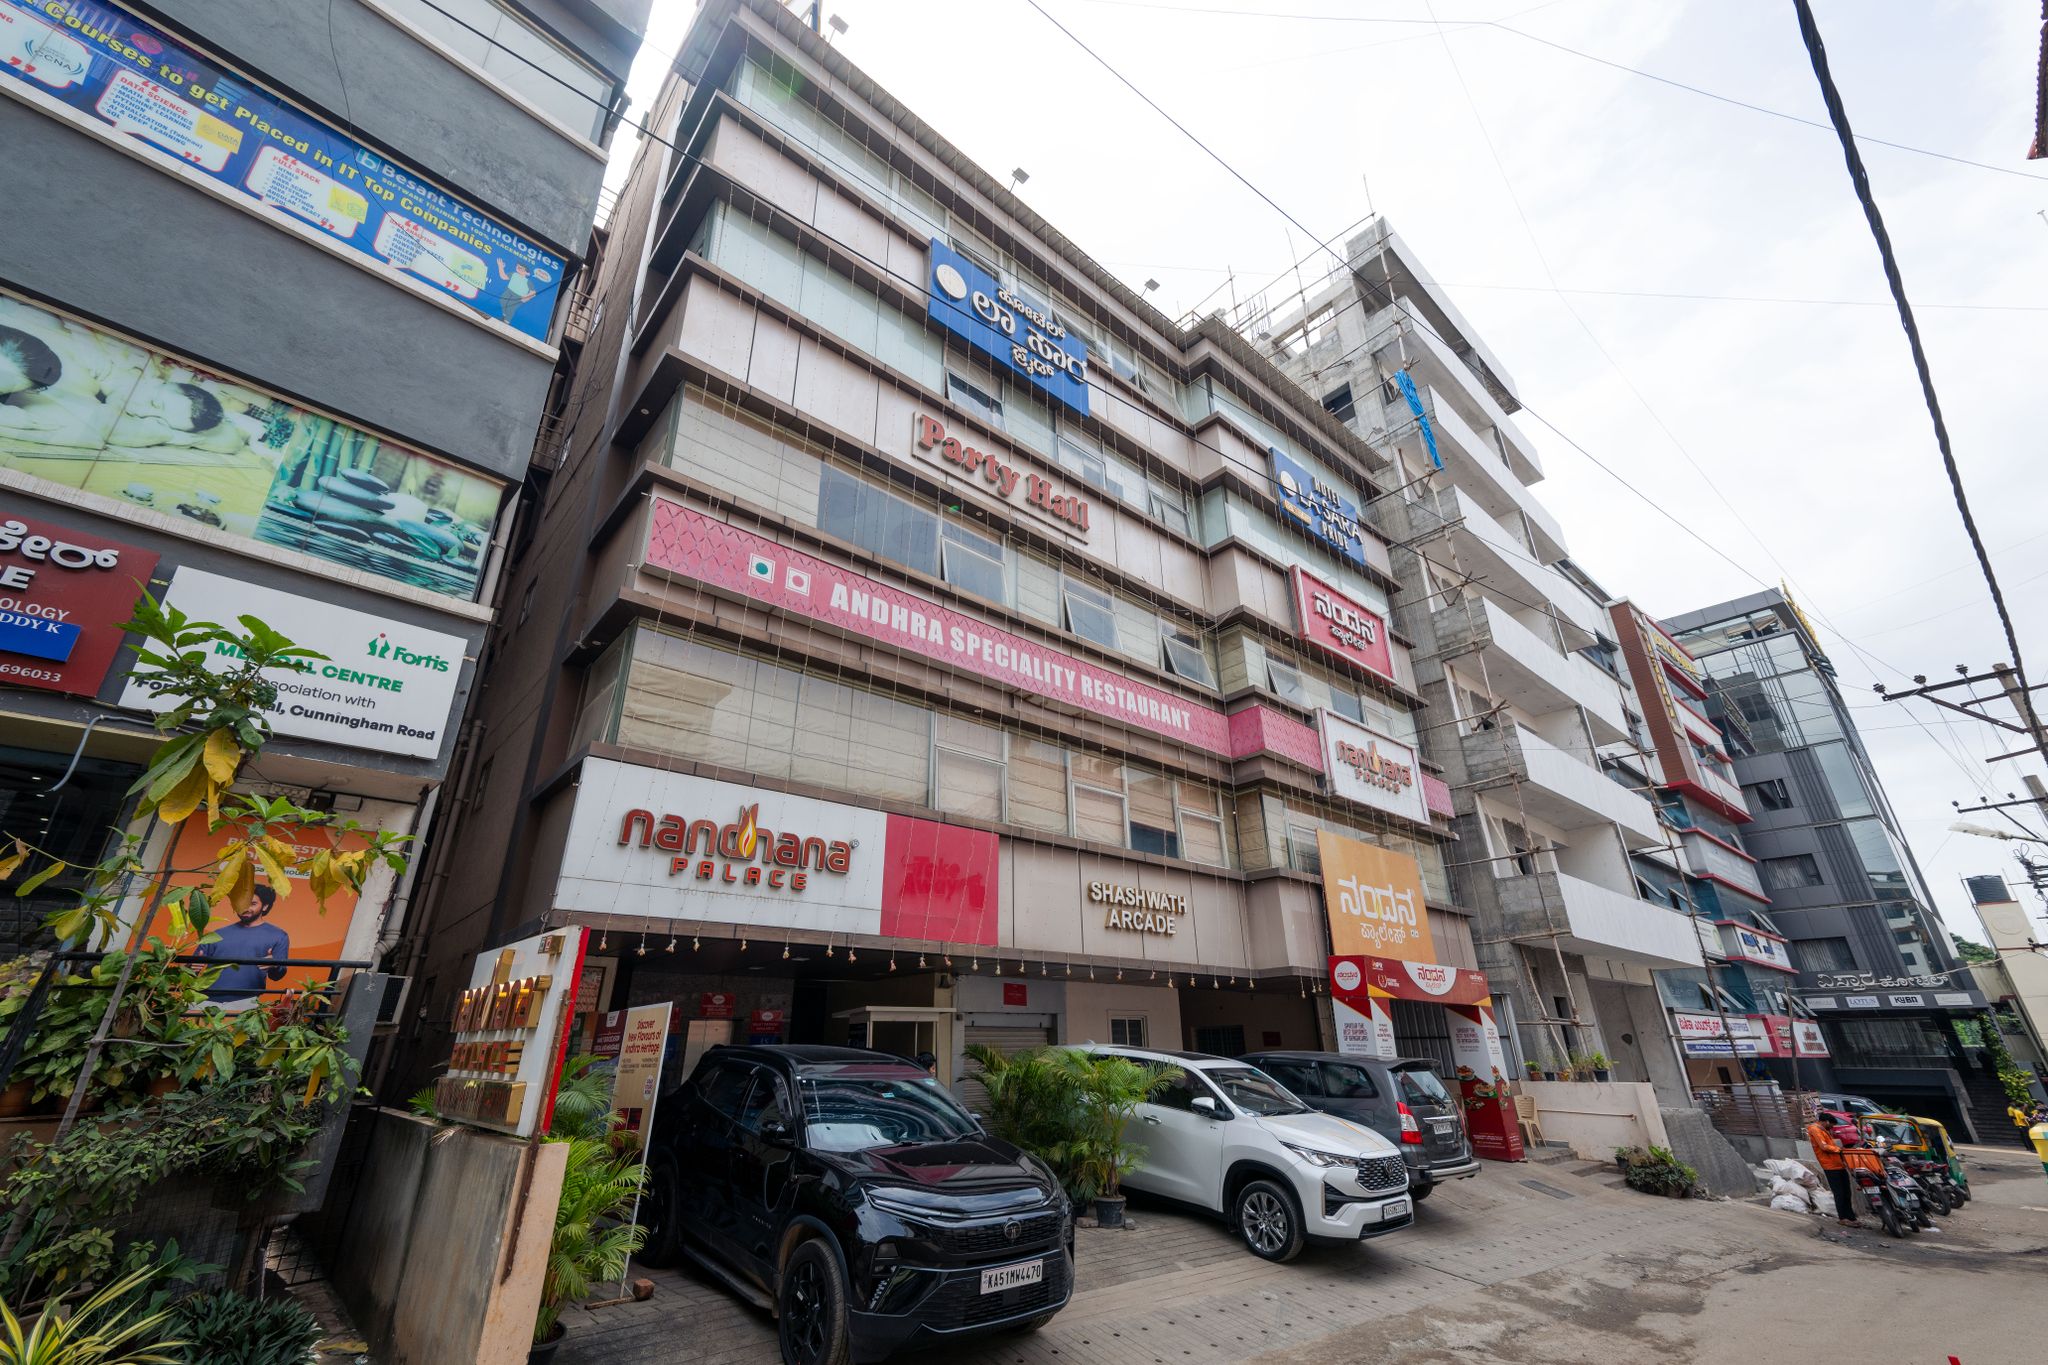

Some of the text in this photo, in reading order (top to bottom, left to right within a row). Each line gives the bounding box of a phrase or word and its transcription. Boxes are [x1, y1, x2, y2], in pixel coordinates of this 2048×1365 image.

[115, 94, 146, 113] PYTHON
[118, 89, 192, 131] MACHINE LEARNING
[120, 76, 188, 116] DATA SCIENCE
[121, 84, 142, 99] MATH
[153, 102, 193, 126] STATISTICS
[44, 1, 152, 68] Courses
[160, 65, 183, 84] to
[189, 84, 229, 110] get
[235, 106, 309, 154] Placed
[314, 150, 333, 167] in
[339, 162, 359, 180] IT
[365, 176, 395, 201] Top
[400, 197, 493, 255] Companies
[106, 108, 121, 119] SQL
[112, 99, 168, 131] VISUALIZATION
[127, 113, 148, 126] DEEP
[149, 125, 187, 146] LEARNING
[272, 155, 321, 184] FULL STACK
[264, 192, 287, 207] MYSQL
[271, 179, 308, 200] BOOTSTRAP
[381, 163, 559, 270] Besant Technologies
[382, 177, 424, 204] SOFTWARE
[425, 200, 461, 224] TRAINING
[470, 226, 489, 241] 100%
[491, 237, 537, 265] PLACEMENTS
[387, 252, 408, 266] MYSQL
[389, 247, 414, 263] PYTHON
[391, 242, 417, 259] TABLEAU
[392, 237, 415, 251] POWER
[973, 291, 1016, 335] ಲಾ
[918, 414, 1090, 532] Party Hall
[1312, 476, 1342, 508] HOTEL
[1298, 482, 1321, 516] LA
[1321, 500, 1363, 545] SARA
[1320, 520, 1349, 551] PRIDE
[47, 621, 63, 635] K
[1313, 591, 1377, 644] ನಂದನ
[392, 646, 449, 673] Fortis
[830, 583, 1192, 732] ANDHRA SPECIALITY RESTAURANT
[322, 664, 404, 693] CENTRE
[344, 693, 376, 709] with
[290, 704, 393, 734] Cunningham
[396, 724, 435, 740] Road
[1335, 740, 1413, 787] nandhana
[1355, 767, 1401, 795] PALACE
[618, 803, 852, 873] nandhana
[669, 857, 808, 891] PALACE
[912, 855, 960, 880] Take
[1088, 881, 1188, 915] SHASHWATH
[1337, 875, 1417, 926] ನಂದನ
[1105, 908, 1177, 936] ARCADE
[1417, 966, 1446, 982] ನಂದನ
[628, 1029, 662, 1042] New Flavours of
[637, 1019, 656, 1029] Discover
[625, 1043, 641, 1053] Andhra
[641, 1042, 660, 1055] Heritage
[988, 1265, 1041, 1289] KA51MW4470
